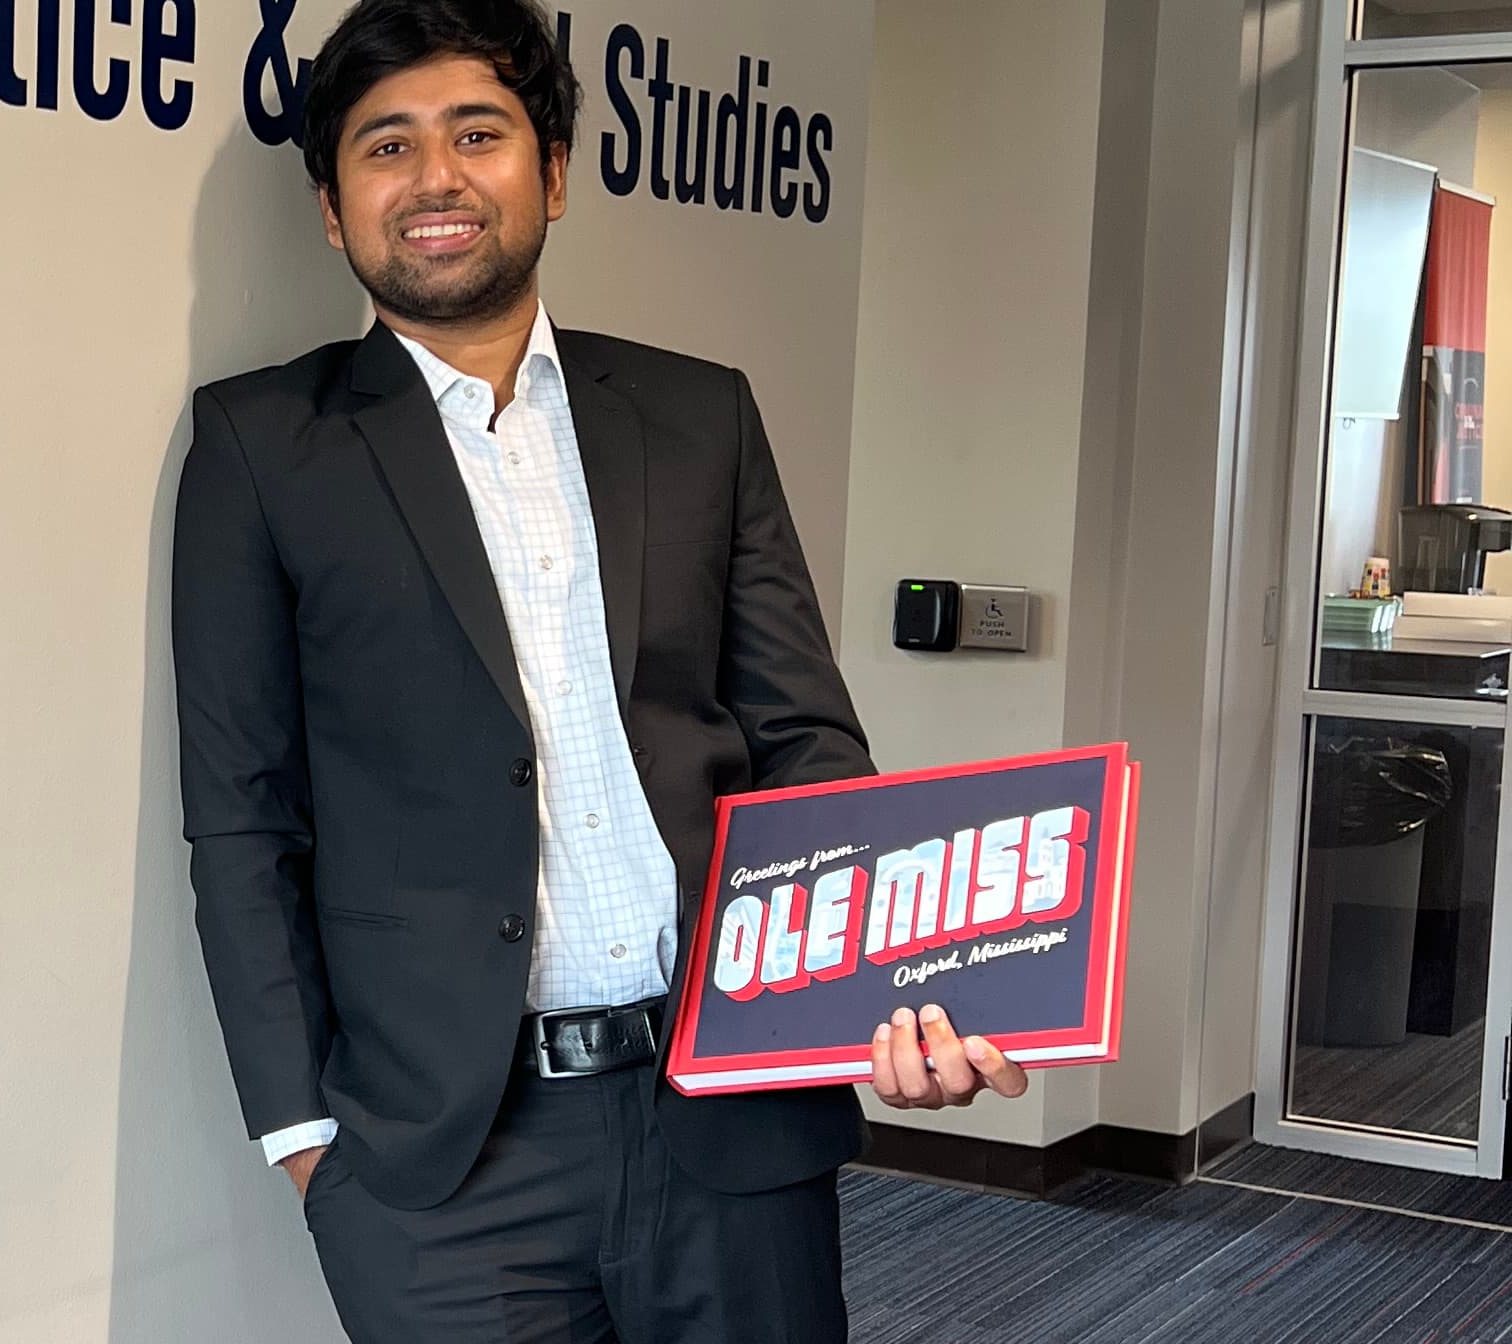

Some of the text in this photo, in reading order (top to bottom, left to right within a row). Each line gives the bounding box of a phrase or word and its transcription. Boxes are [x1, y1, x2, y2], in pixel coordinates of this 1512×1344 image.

[600, 23, 833, 223] Studies
[971, 628, 1012, 637] TO OPEN
[979, 620, 1005, 628] PUSH
[730, 844, 871, 890] Greetings from...
[713, 806, 1089, 1001] OLE MISS
[893, 927, 1069, 988] Oxford, Mississippi
